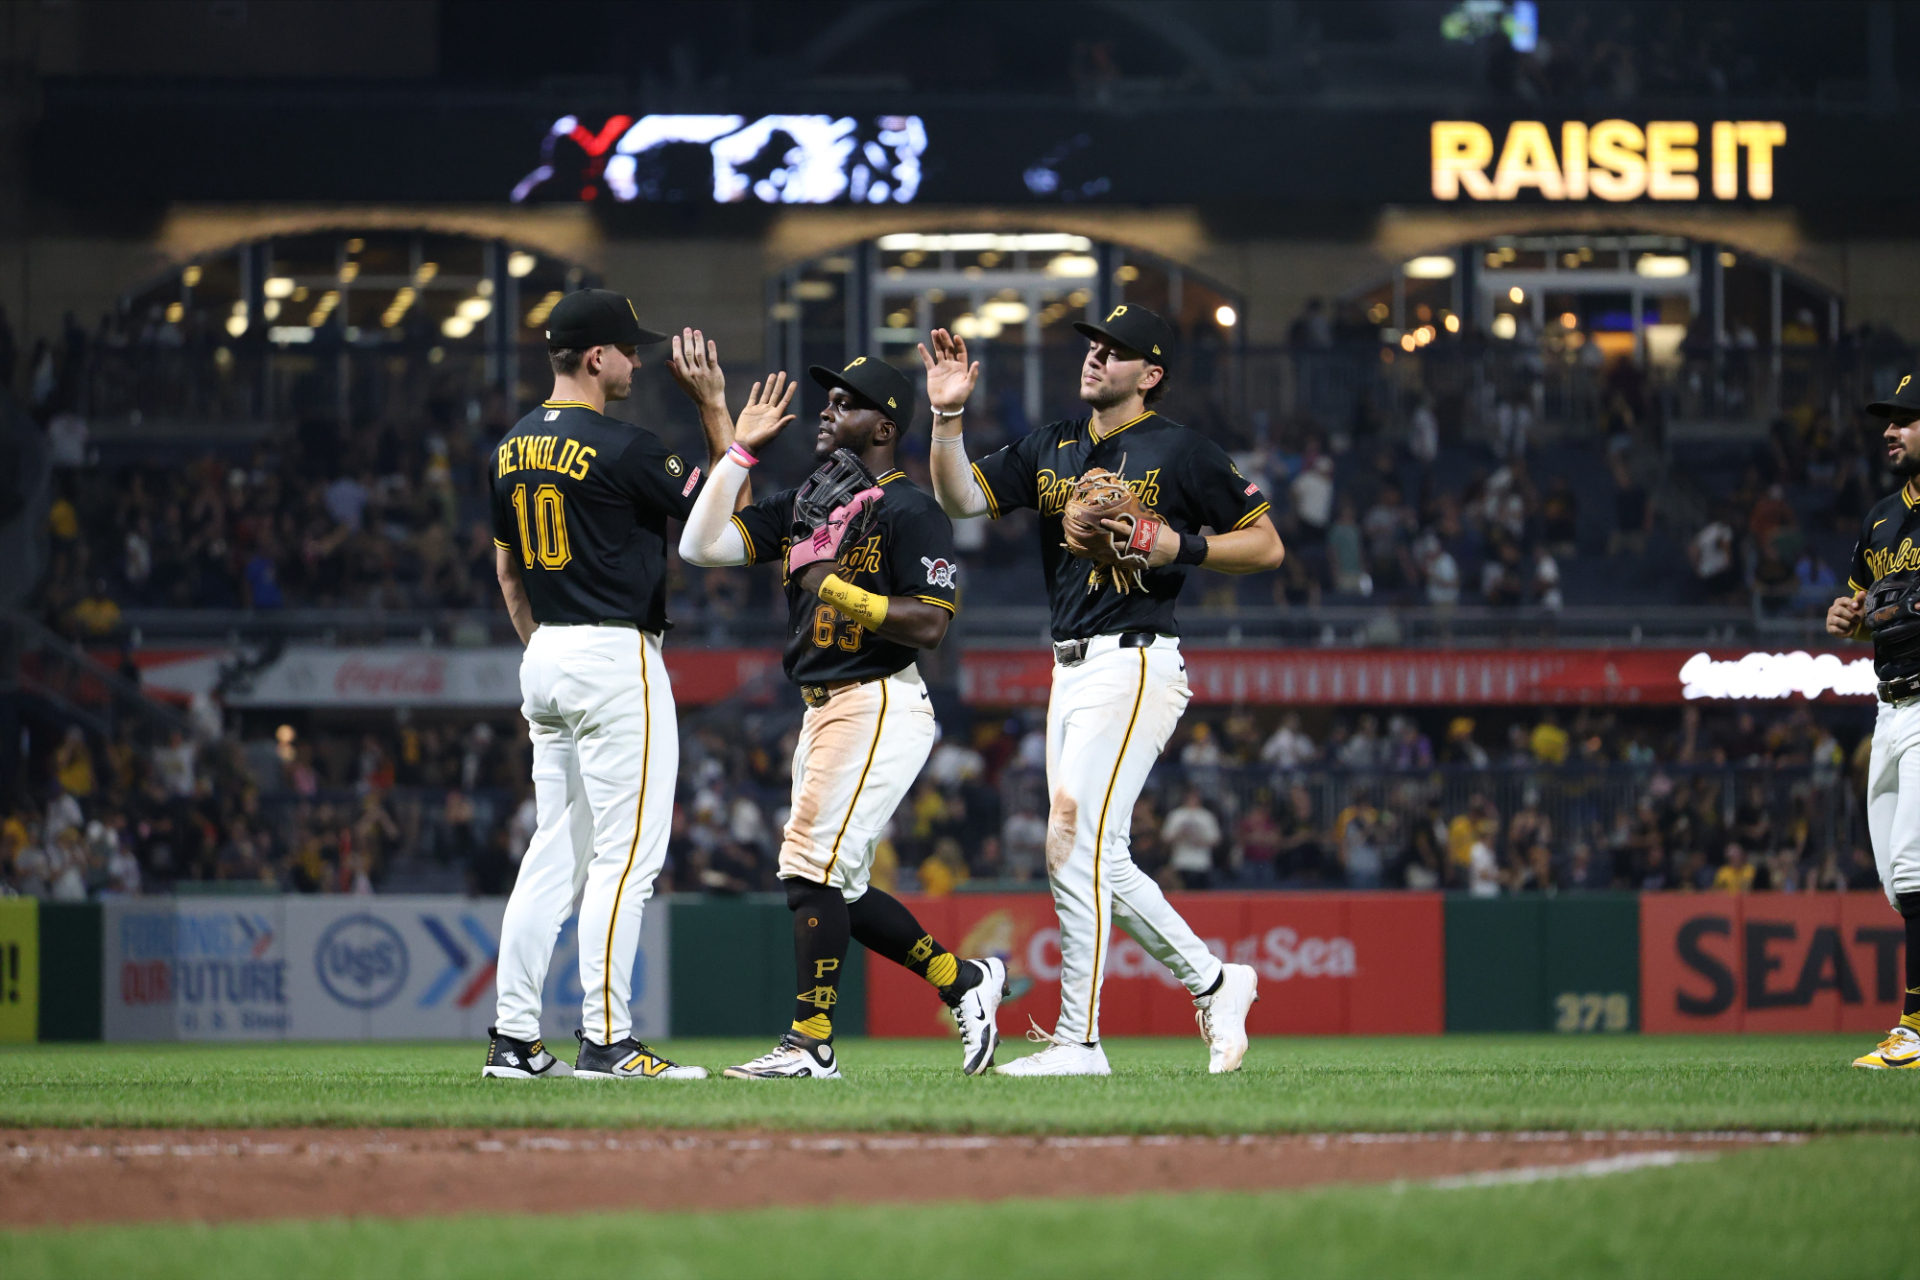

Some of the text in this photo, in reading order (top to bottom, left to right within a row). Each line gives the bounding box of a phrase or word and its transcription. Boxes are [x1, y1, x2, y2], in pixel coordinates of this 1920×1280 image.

[1431, 119, 1787, 201] RAISE IT
[1106, 305, 1128, 322] P
[844, 356, 867, 372] P
[1896, 375, 1912, 394] P
[498, 435, 597, 481] REYNOLDS
[668, 458, 680, 473] 9
[512, 483, 573, 570] 10
[812, 603, 864, 653] 63
[814, 957, 840, 978] P
[1263, 925, 1357, 981] Sea
[1675, 914, 1905, 1016] SEAT
[173, 958, 288, 1004] FUTURE
